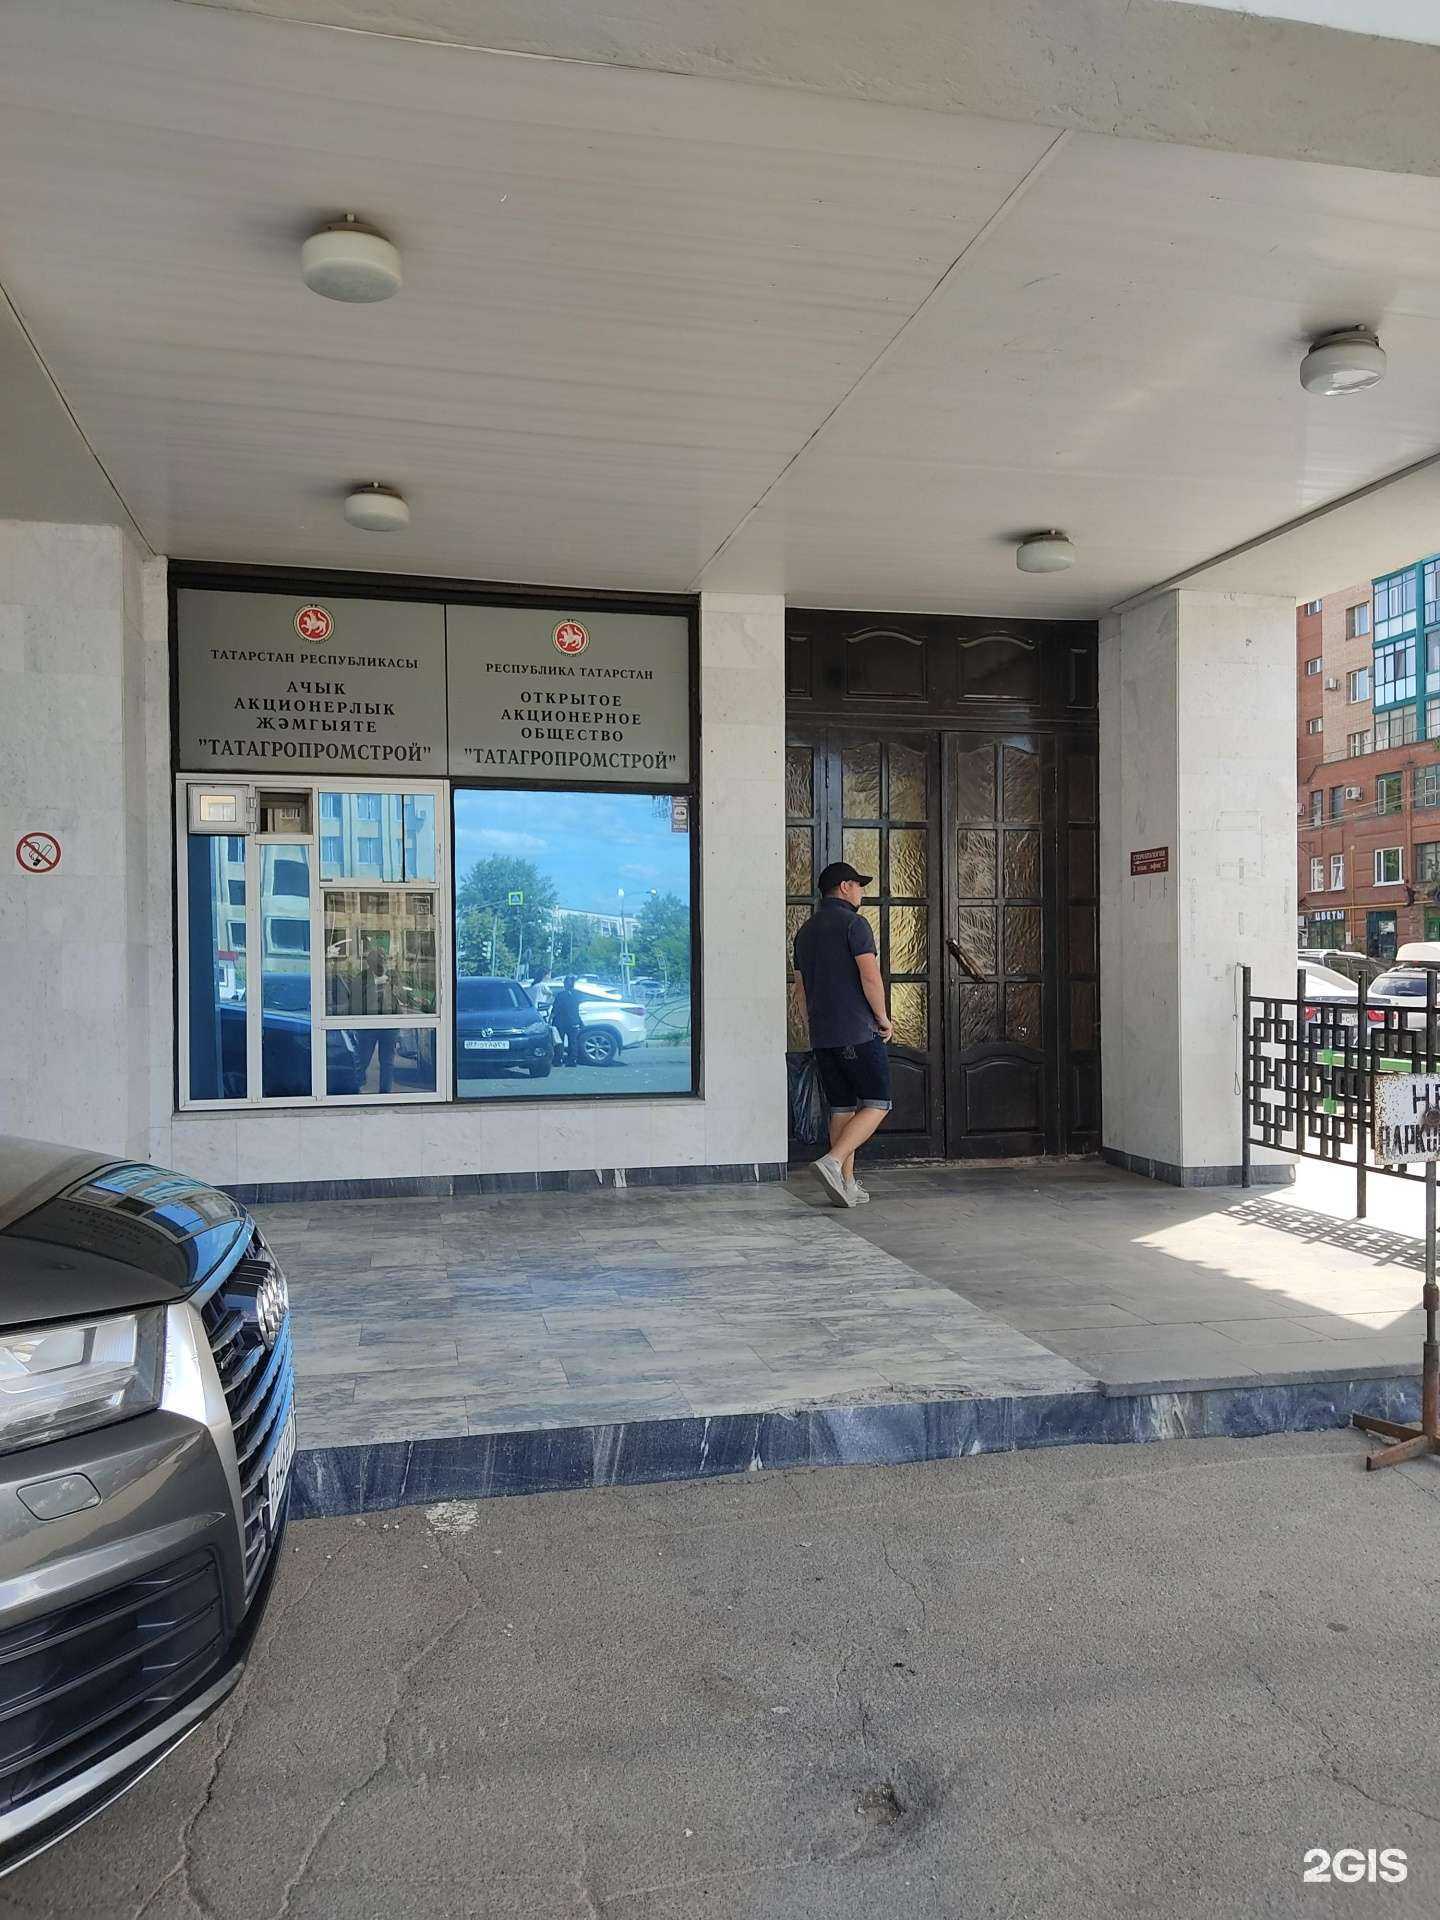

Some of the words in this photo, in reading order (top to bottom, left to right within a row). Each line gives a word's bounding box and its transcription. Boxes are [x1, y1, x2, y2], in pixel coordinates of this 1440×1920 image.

[208, 649, 295, 665] ТАТАРСТАН
[299, 653, 419, 669] РЕСПУБЛИКАСЫ
[485, 662, 576, 678] РЕСПУБЛИКА
[579, 666, 654, 681] ТАТАРСТАН
[286, 680, 347, 696] АЧЫК
[233, 697, 396, 717] АКЦИОНЕРЛЫК
[520, 690, 623, 708] ОТКРЫТОЕ
[500, 708, 642, 727] АКЦИОНЕРНОЕ
[520, 727, 624, 743] ОБЩЕСТВО
[1315, 910, 1345, 921] ЦВЕТЫ
